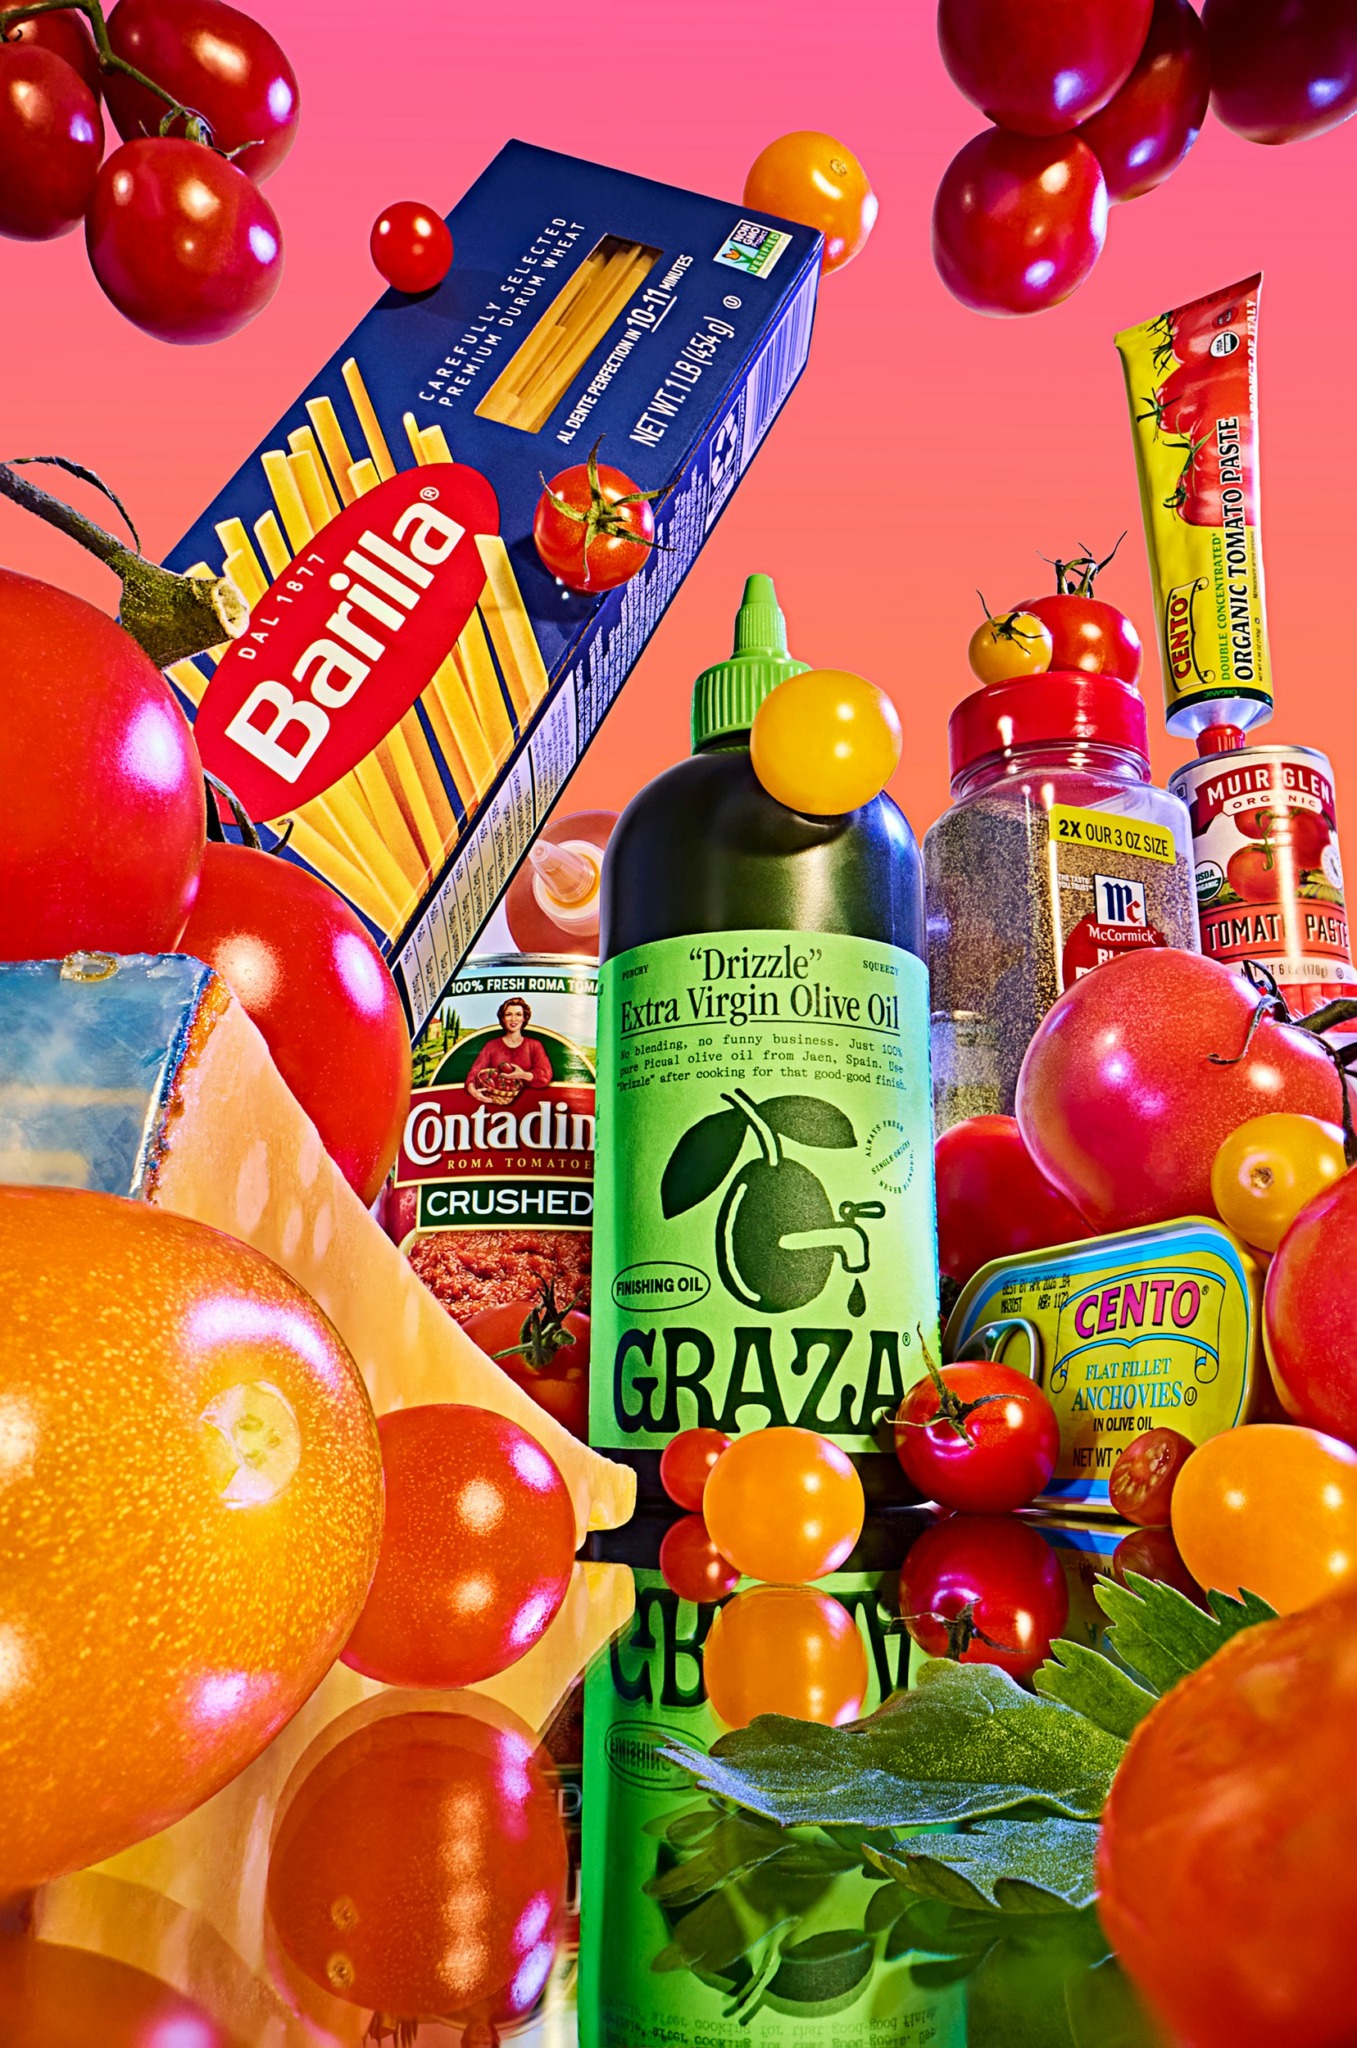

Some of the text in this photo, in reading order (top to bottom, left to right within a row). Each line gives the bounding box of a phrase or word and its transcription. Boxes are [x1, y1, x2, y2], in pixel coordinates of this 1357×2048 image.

[732, 224, 751, 241] NON
[743, 227, 760, 245] GMO
[749, 234, 780, 271] VERIFIED
[419, 218, 566, 401] CAREFULLY SELECTED
[439, 222, 585, 407] PREMIUM DURUM WHEAT
[1246, 300, 1256, 335] ITALY
[557, 254, 693, 444] AL DENTE PERFECTION IN 10-11 MINUTES
[629, 316, 735, 448] NET WT. 1 LB (454 g)
[1218, 418, 1253, 680] ORGANIC TOMATO PASTE
[238, 553, 325, 659] DAL 1877
[224, 502, 466, 784] Barilla
[1170, 598, 1192, 679] CENTO
[1219, 632, 1230, 680] DOUBLE
[1207, 768, 1330, 806] MUIR GLEN
[1233, 795, 1316, 808] ORGNIC
[1059, 819, 1169, 857] 2X OUR 3 OZ SIZE
[1088, 924, 1156, 944] McCormick
[1305, 914, 1349, 950] PASTE
[622, 964, 648, 981] PUNCHY
[863, 960, 899, 976] SQUEEZY
[451, 979, 484, 994] 100%
[487, 978, 525, 991] FRESH
[529, 978, 565, 991] ROMA
[620, 997, 680, 1034] Extra
[687, 984, 780, 1026] Virgin
[790, 982, 860, 1021] Olive
[868, 993, 900, 1030] Oil
[621, 1033, 903, 1060] No blending, no funny business. Just 100%
[620, 1050, 903, 1079] pure Picual olive oil from Jaen, Spain. Use
[660, 1070, 690, 1083] after
[696, 1067, 745, 1079] cooking
[752, 1066, 773, 1077] for
[781, 1067, 808, 1078] that
[814, 1070, 870, 1083] good-good
[876, 1076, 907, 1090] finish.
[866, 1120, 904, 1157] ALWAYS FRESH
[448, 1158, 494, 1169] ROMA
[871, 1154, 894, 1175] SINGLE
[426, 1189, 594, 1216] CRUSHED
[879, 1180, 902, 1194] NEVER
[616, 1277, 703, 1296] FINISHING OIL
[1074, 1279, 1200, 1339] CENTO
[613, 1326, 904, 1436] GRAZA
[1086, 1358, 1172, 1380] FLAT FILLET
[1072, 1380, 1183, 1411] ANCHOVIES
[1093, 1416, 1154, 1432] IN OLIVE OIL
[1073, 1448, 1094, 1467] NET
[1096, 1448, 1113, 1467] WT
